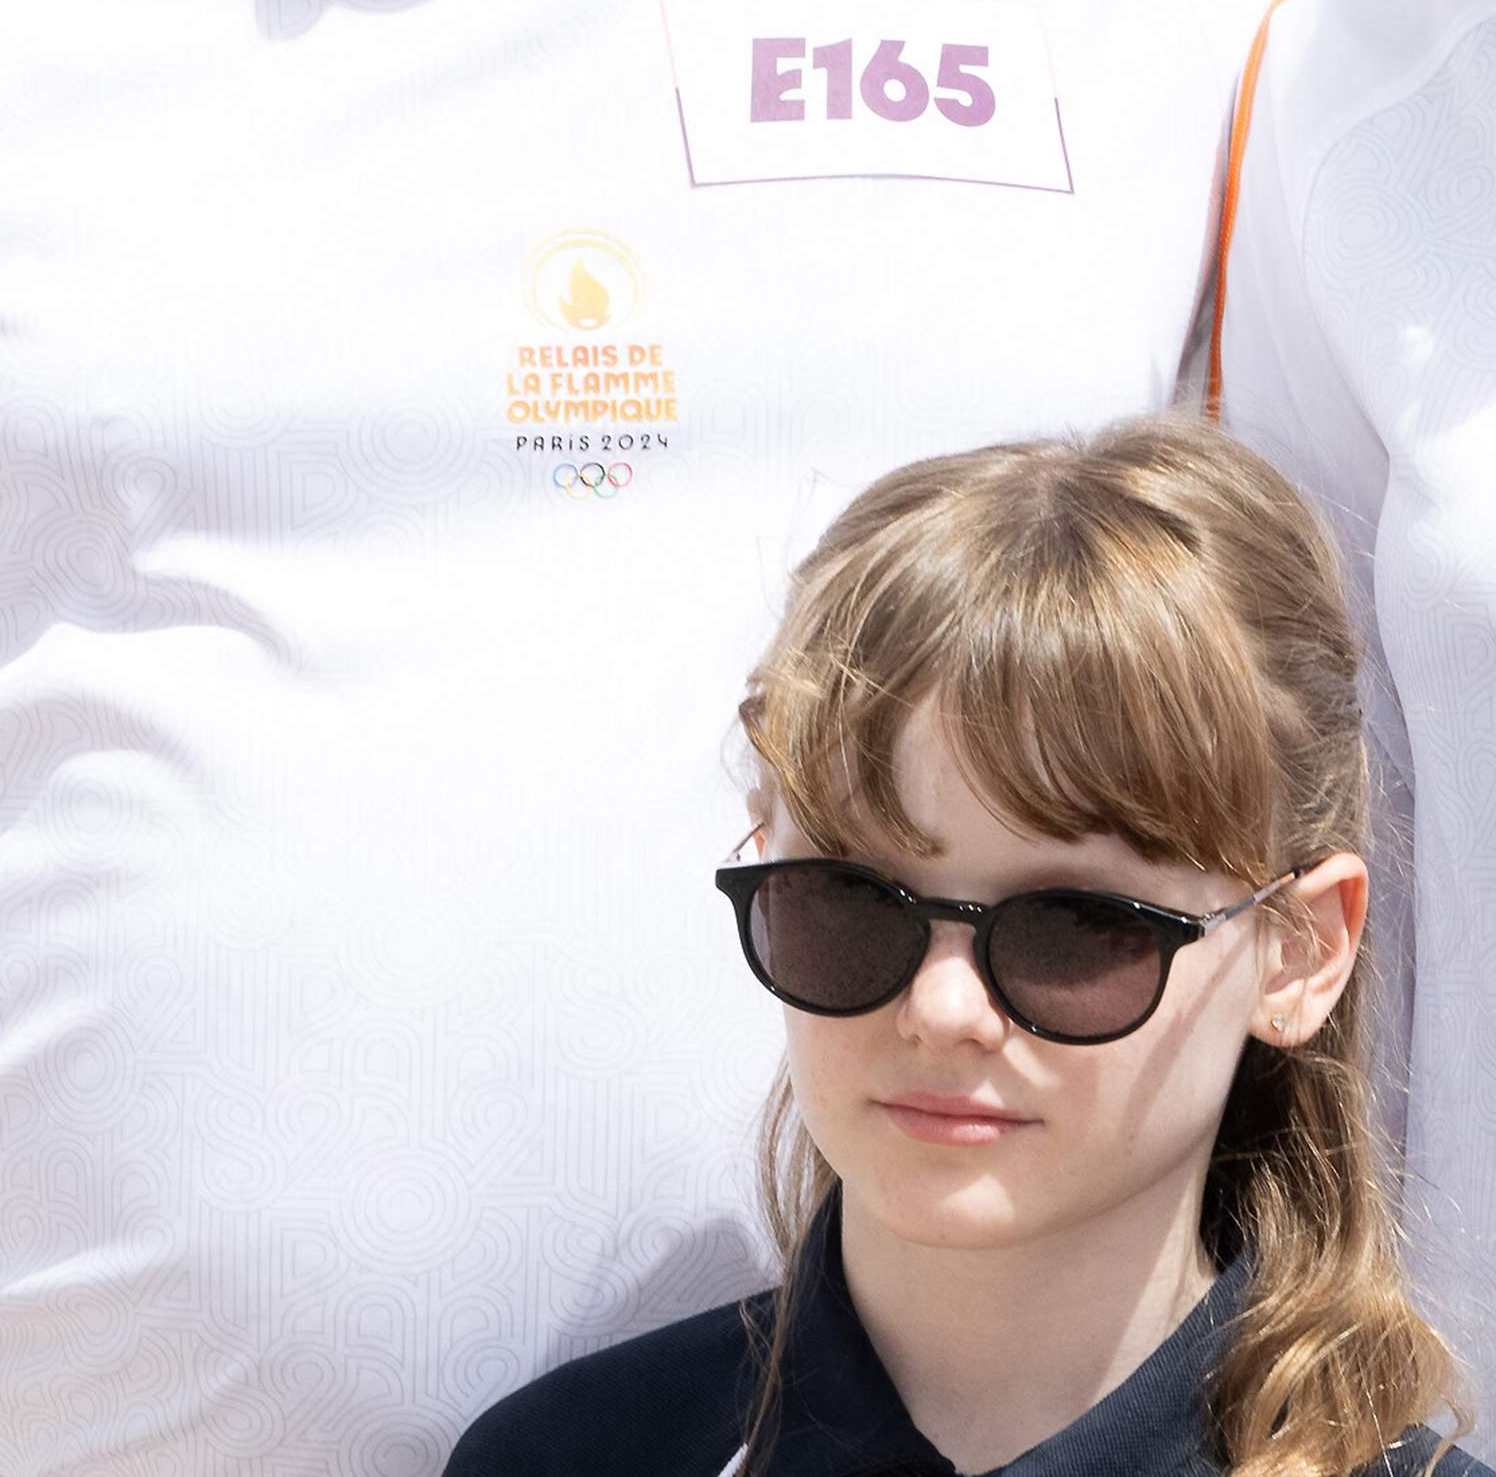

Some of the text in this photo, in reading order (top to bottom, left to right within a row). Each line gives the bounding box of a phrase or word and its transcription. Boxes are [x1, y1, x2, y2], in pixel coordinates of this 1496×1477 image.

[750, 37, 996, 128] E165
[518, 344, 664, 368] RELAIS DE
[506, 370, 677, 396] LA FLAMME
[506, 398, 679, 423] OLYMPIQUE
[601, 433, 669, 451] 2024
